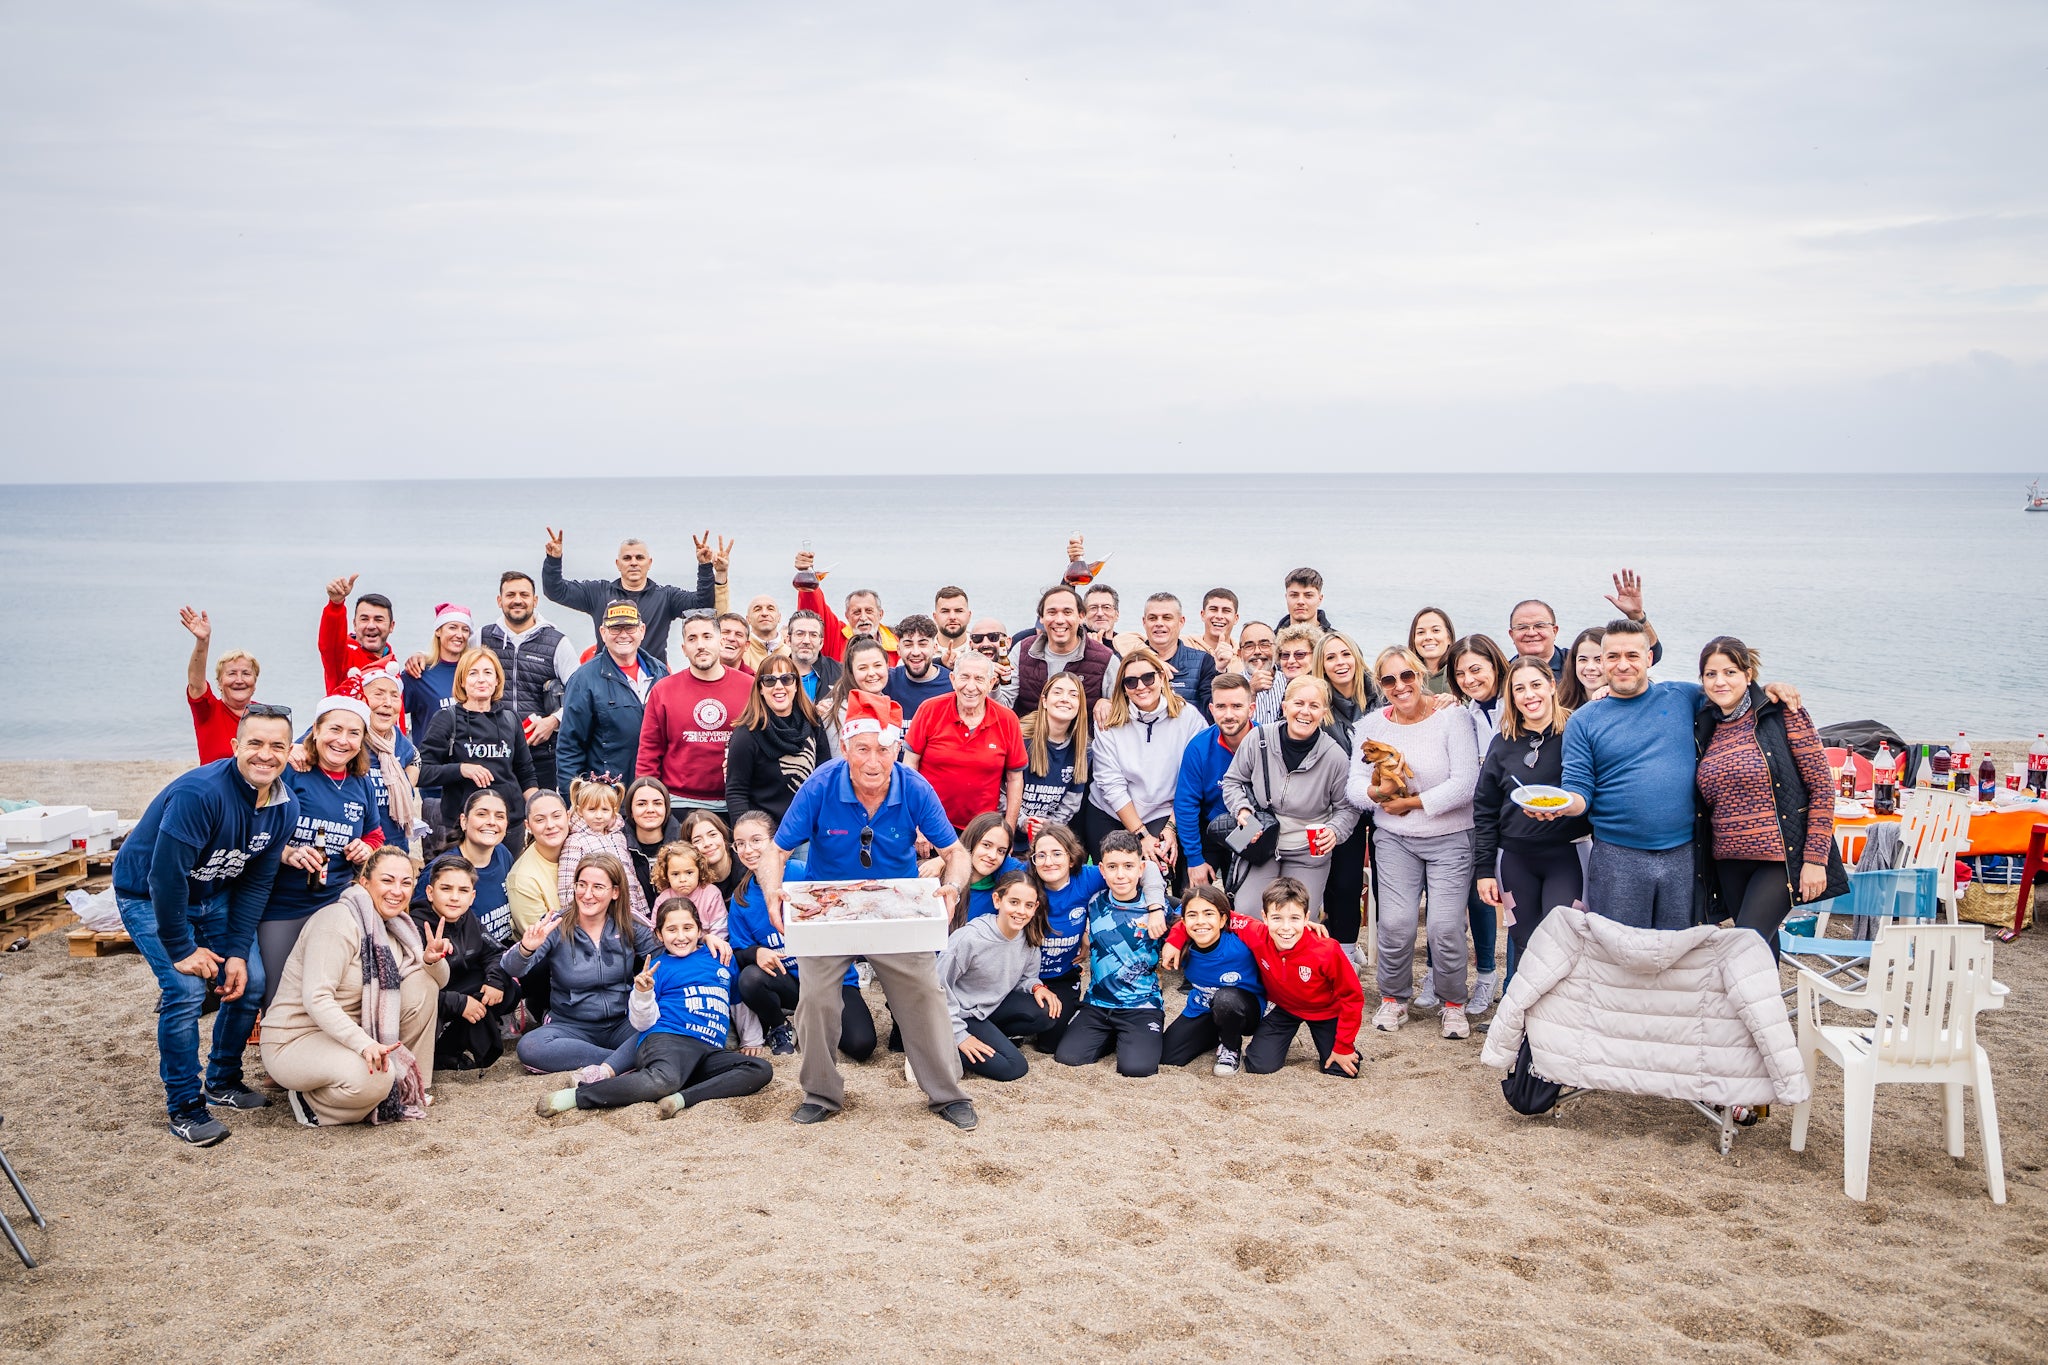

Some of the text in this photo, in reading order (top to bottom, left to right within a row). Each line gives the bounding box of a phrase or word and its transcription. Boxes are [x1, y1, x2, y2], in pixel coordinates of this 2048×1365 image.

[1024, 783, 1036, 793] LA
[1022, 791, 1037, 802] DEL
[297, 815, 354, 837] LA MORAGA
[294, 827, 313, 841] DEL
[211, 848, 226, 858] LA
[481, 912, 491, 925] LA
[684, 985, 698, 998] LA
